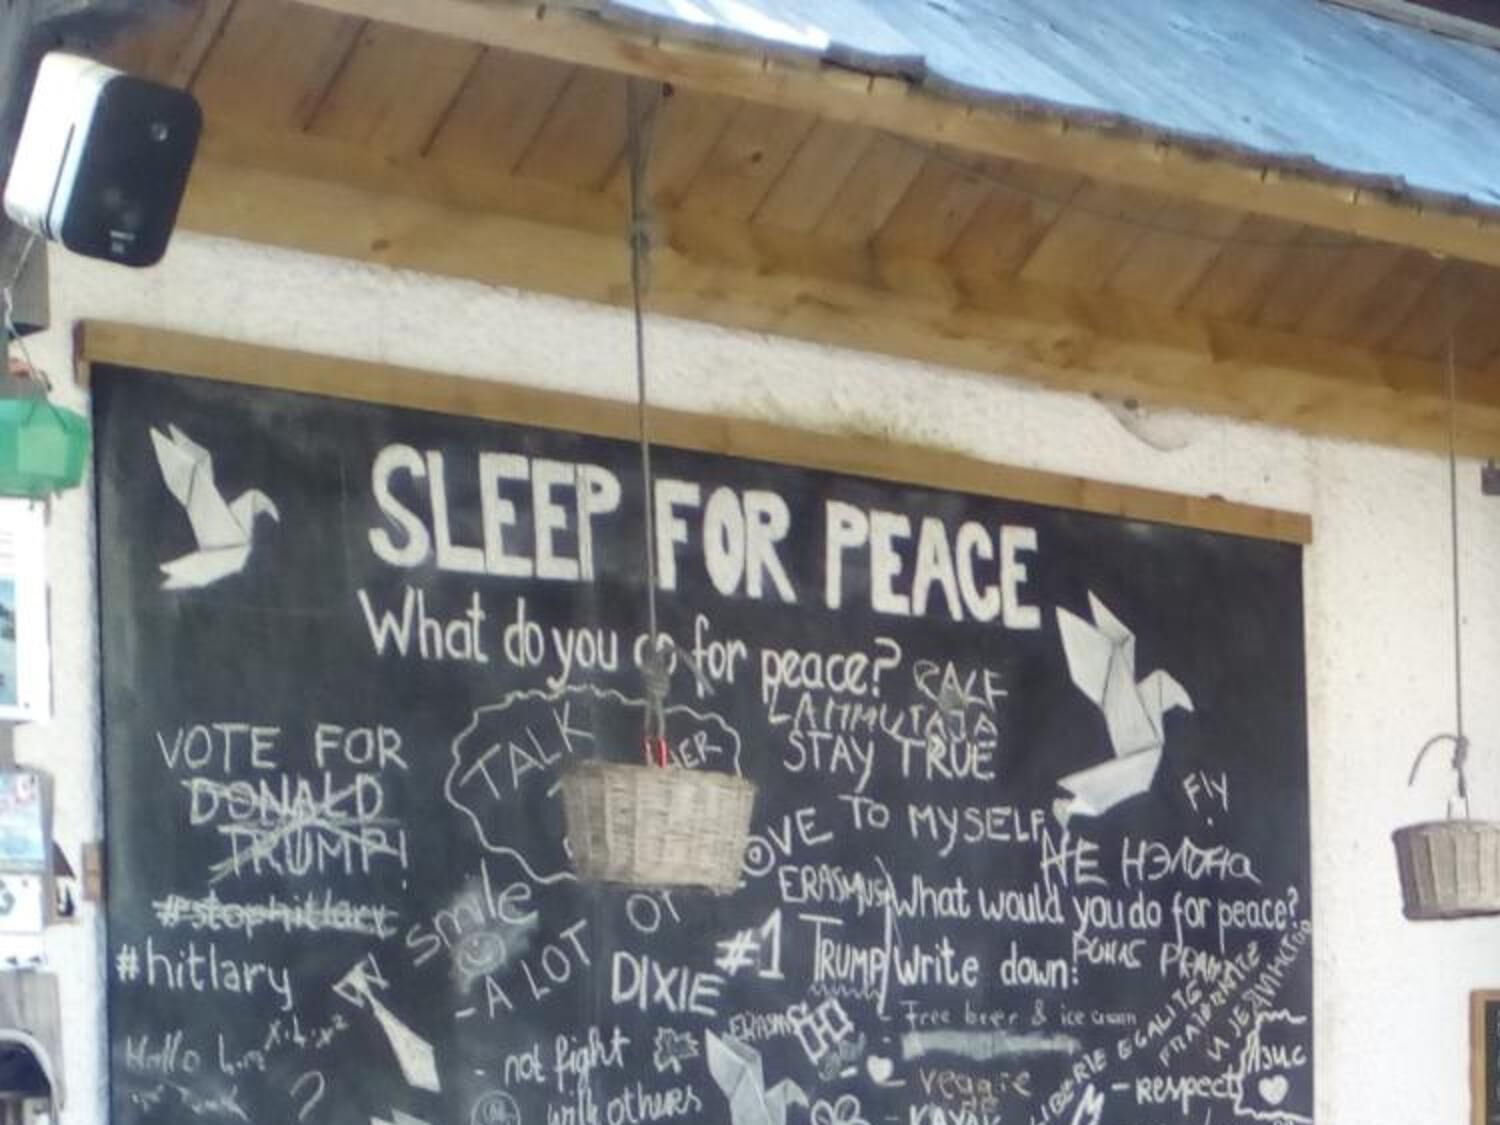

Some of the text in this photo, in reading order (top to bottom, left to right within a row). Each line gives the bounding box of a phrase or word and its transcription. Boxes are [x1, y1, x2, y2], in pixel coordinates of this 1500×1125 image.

[368, 443, 1041, 630] SLEEP FOR PEACE
[357, 586, 488, 663] What
[504, 596, 545, 668] do
[545, 622, 618, 692] you
[691, 613, 748, 698] for
[760, 637, 903, 704] peace?
[157, 723, 408, 770] VOTE FOR
[459, 700, 595, 800] TALK
[783, 729, 997, 794] STAY TRUE
[838, 795, 890, 834] TO
[907, 804, 1047, 859] MYSELF
[714, 907, 785, 980] #1
[893, 874, 971, 918] What
[977, 882, 1065, 925] would
[1072, 895, 1124, 935] you
[1129, 889, 1162, 930] do
[1171, 889, 1212, 949] for
[116, 934, 294, 1012] #hitlary
[485, 975, 514, 1019] A
[521, 918, 592, 1001] LOT
[611, 951, 725, 1017] DIXIE
[504, 1043, 545, 1087] not
